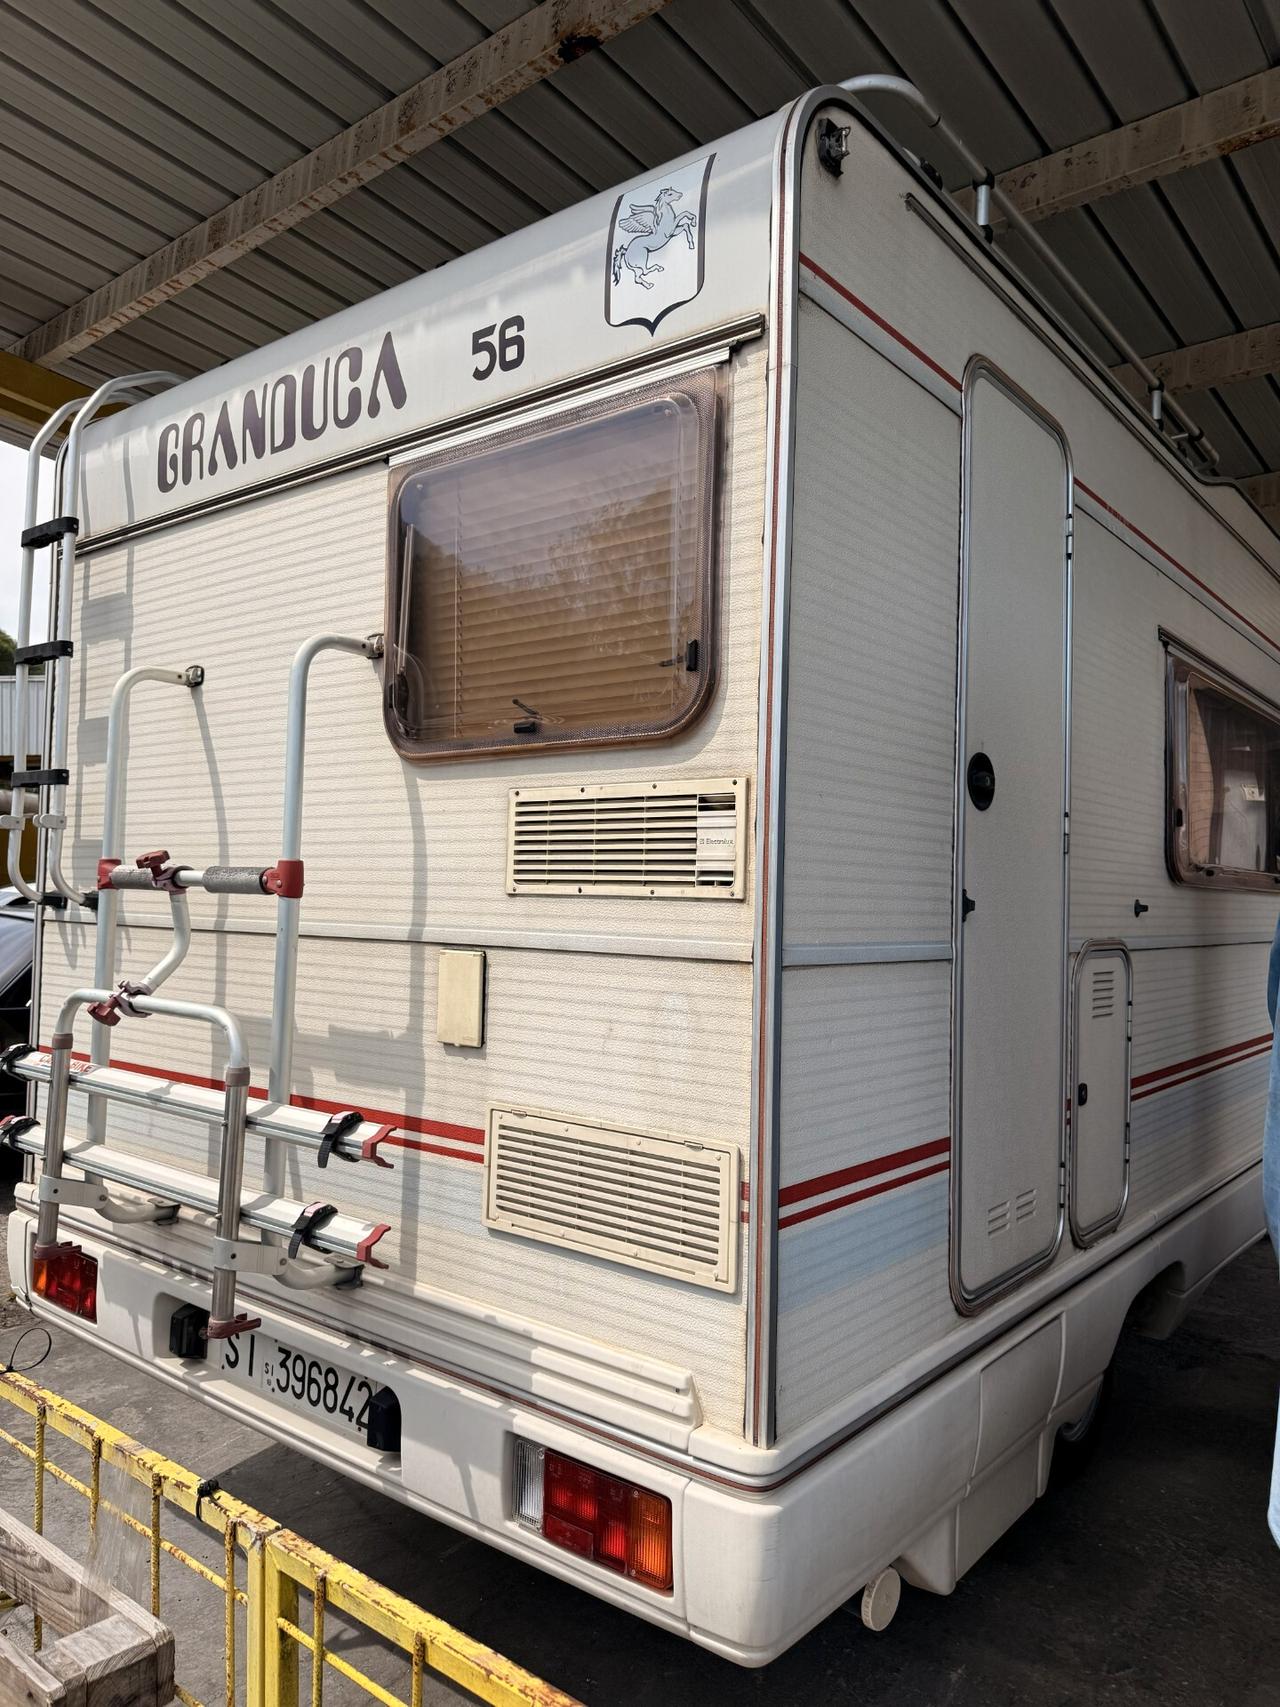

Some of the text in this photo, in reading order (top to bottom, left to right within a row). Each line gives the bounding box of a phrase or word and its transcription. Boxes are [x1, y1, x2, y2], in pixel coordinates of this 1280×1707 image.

[157, 314, 526, 494] GRANDUCA 56
[225, 1333, 373, 1430] SI 396842
